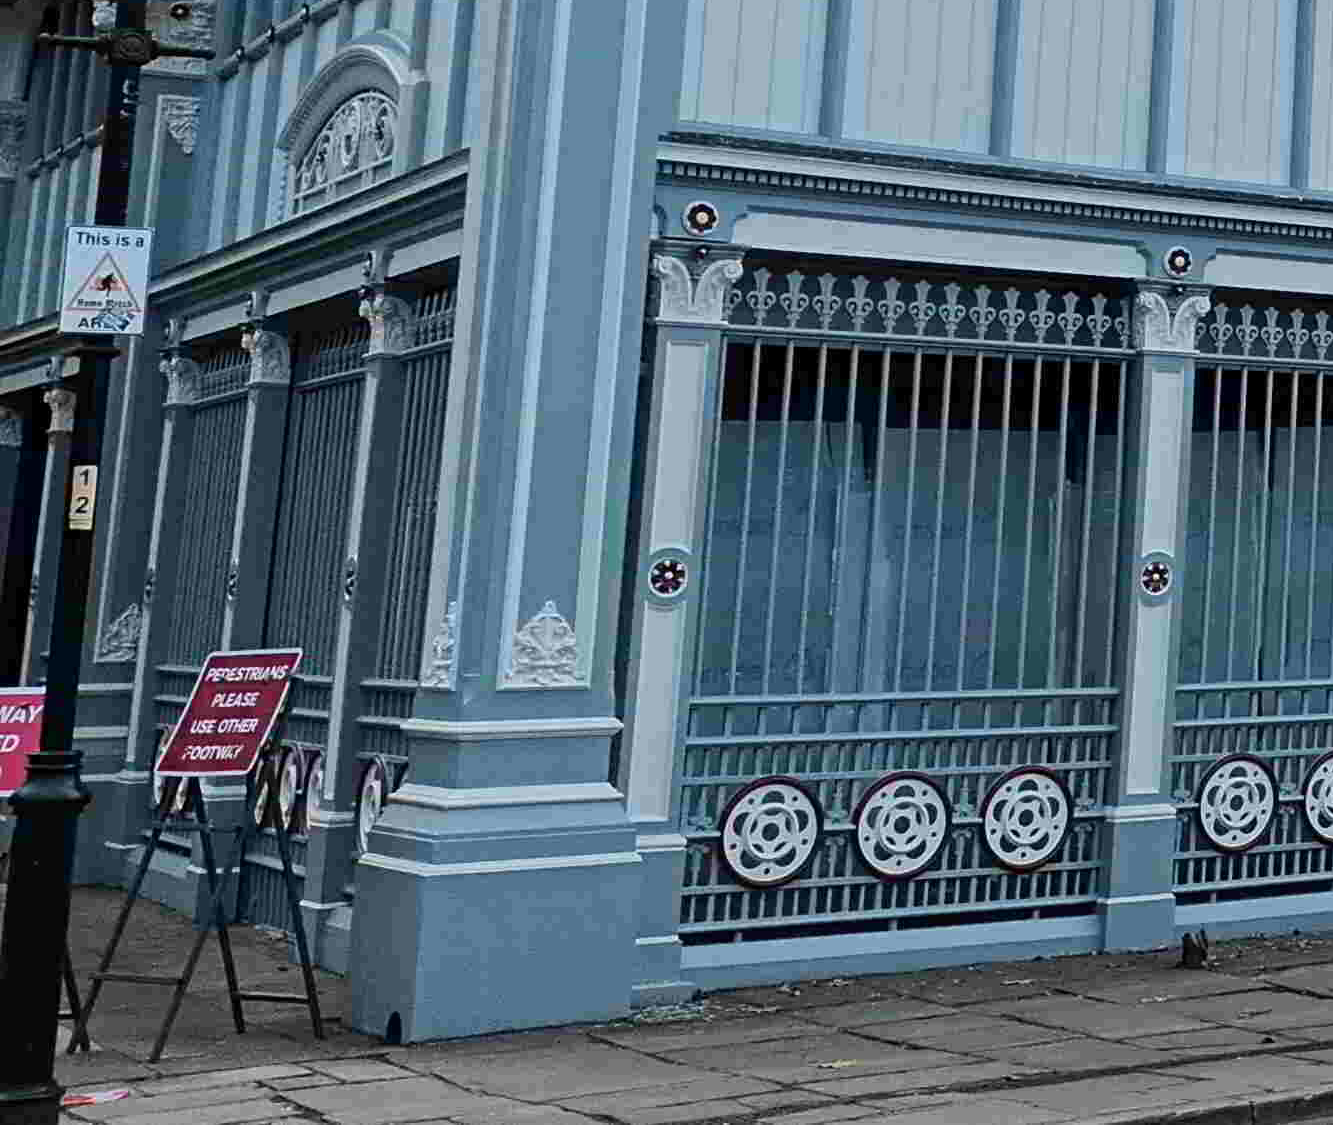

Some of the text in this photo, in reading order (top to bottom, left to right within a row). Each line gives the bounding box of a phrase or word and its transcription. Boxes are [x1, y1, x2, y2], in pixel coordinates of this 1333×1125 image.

[76, 231, 144, 248] This is a
[79, 468, 89, 486] 1
[75, 496, 89, 514] 2
[204, 664, 289, 682] PEDESTRIANS
[210, 692, 260, 707] PLEASE
[190, 718, 258, 734] USE OTHER
[182, 744, 244, 760] FOOTWAY
